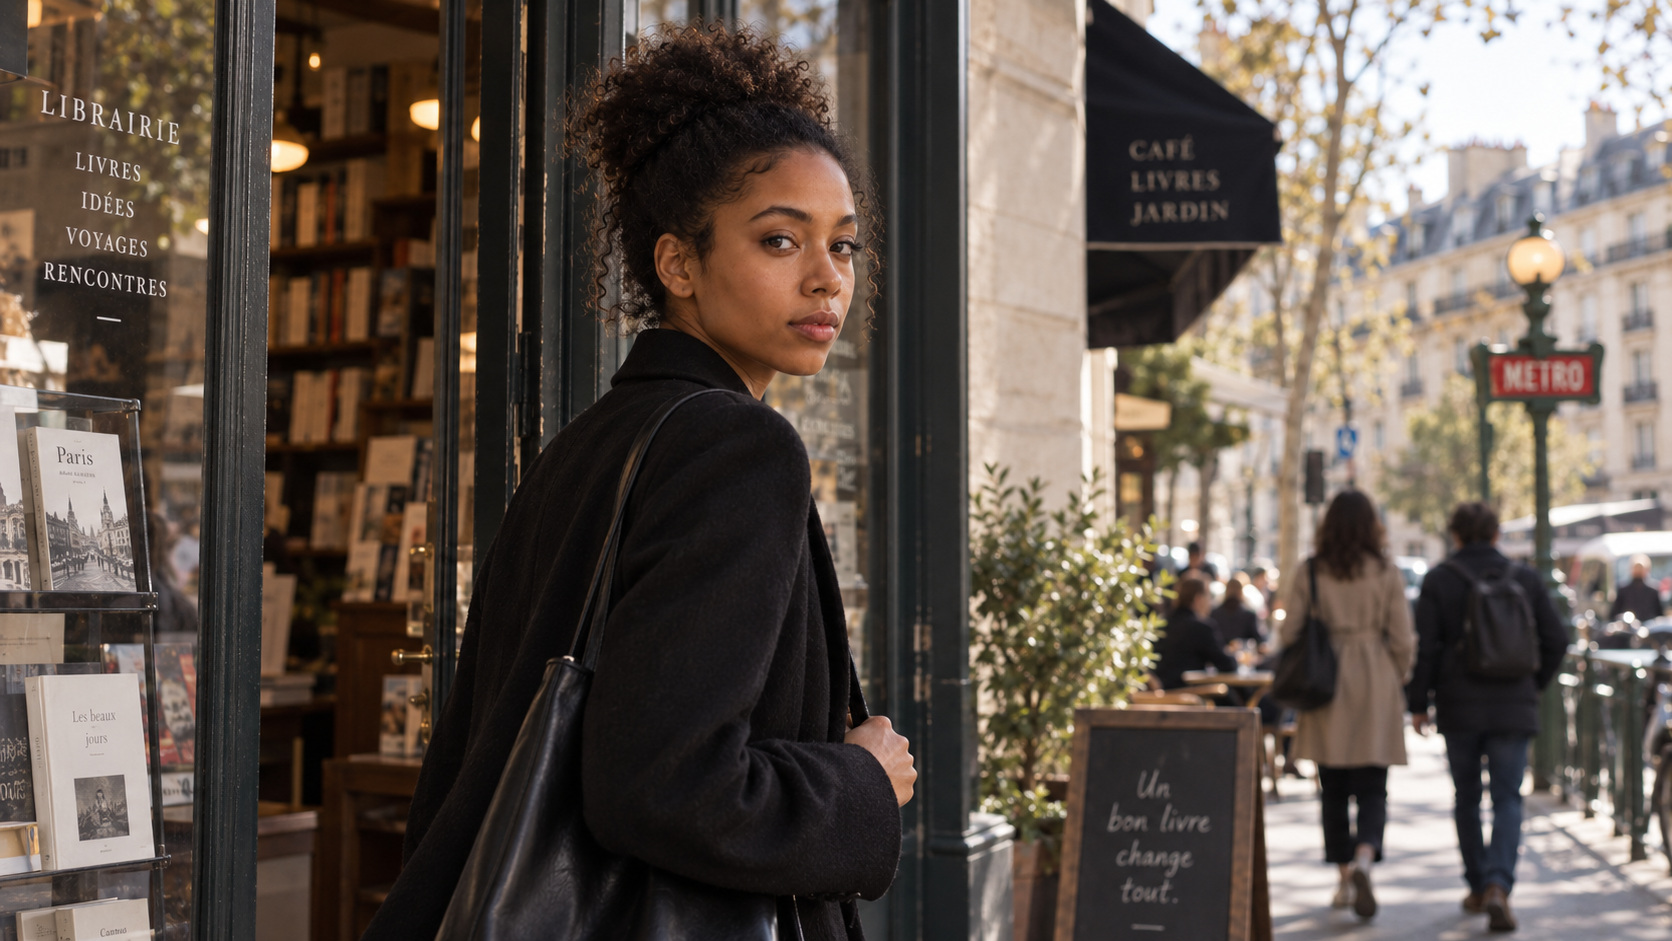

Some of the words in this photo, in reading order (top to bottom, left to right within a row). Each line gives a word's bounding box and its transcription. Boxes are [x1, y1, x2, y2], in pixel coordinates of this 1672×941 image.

[41, 90, 180, 145] LIBRAIRIE
[1128, 133, 1196, 161] CAFÉ
[75, 152, 141, 182] LIVRES
[1130, 169, 1221, 192] LIVRES
[81, 191, 135, 218] IDÉES
[1130, 200, 1229, 227] JARDIN
[66, 226, 148, 257] VOYAGES
[44, 261, 167, 298] RENCONTRES
[56, 446, 94, 466] Paris
[72, 710, 88, 723] Les
[90, 708, 116, 722] beaux
[85, 732, 108, 749] jours
[1136, 768, 1171, 799] Un
[1107, 801, 1149, 833] bon
[1159, 802, 1212, 833] livre
[1115, 838, 1194, 878] change
[1120, 876, 1179, 904] tout.
